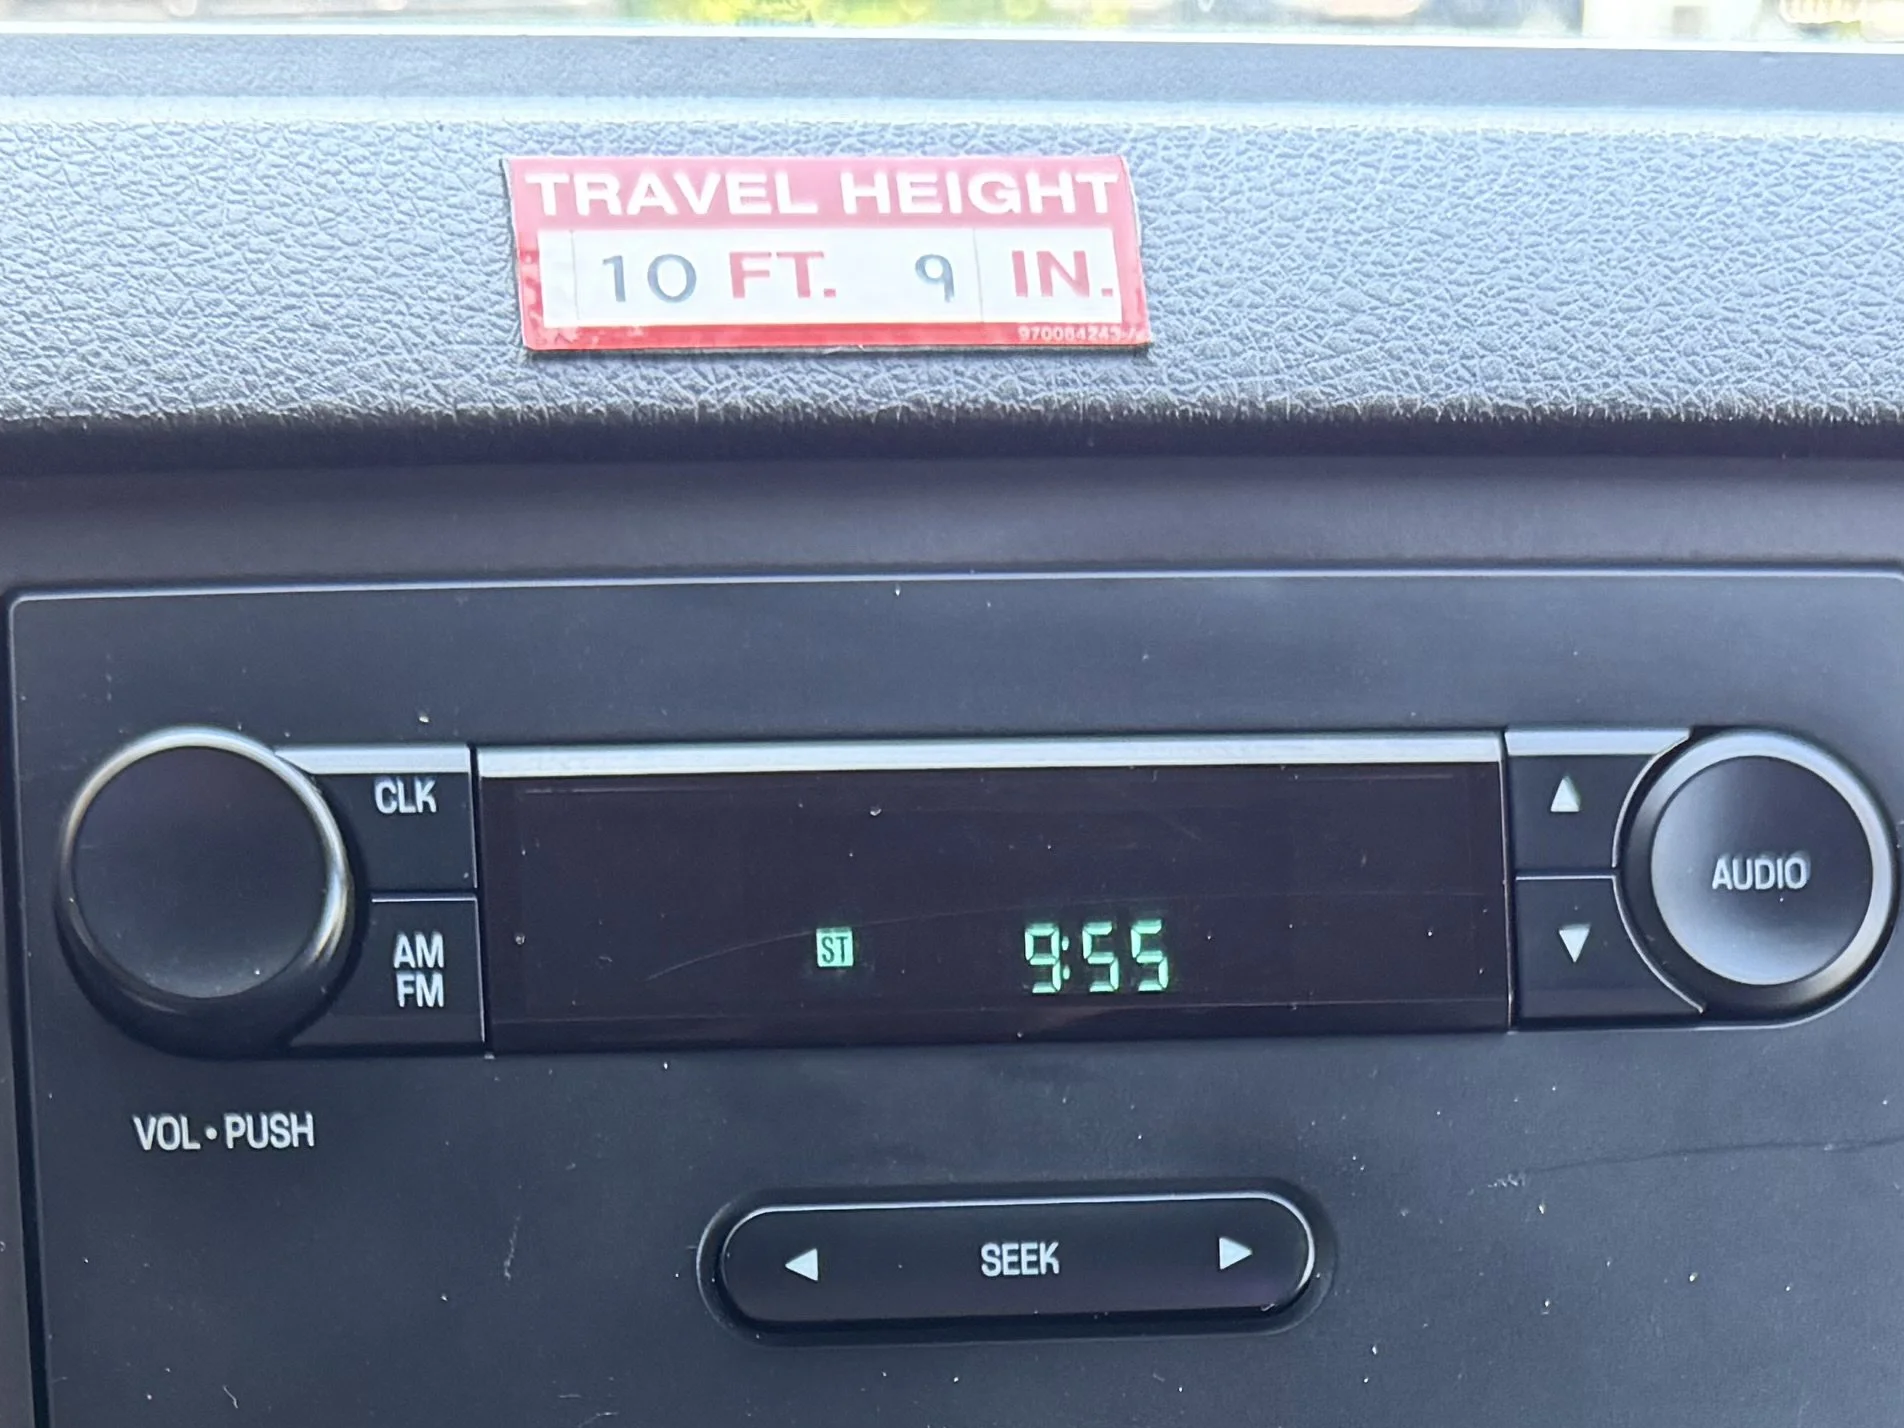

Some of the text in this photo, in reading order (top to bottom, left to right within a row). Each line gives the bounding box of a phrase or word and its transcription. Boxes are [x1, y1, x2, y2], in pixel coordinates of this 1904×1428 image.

[524, 169, 1119, 217] TRAVEL HEIGHT
[601, 248, 1116, 304] 10 FT. 9 IN.
[374, 778, 438, 814] CLK
[1711, 854, 1810, 890] AUDIO
[392, 932, 445, 970] AM
[818, 930, 853, 966] ST
[1023, 918, 1170, 995] 9:55
[396, 971, 445, 1008] FM
[133, 1112, 315, 1152] VOL PUSH
[980, 1241, 1061, 1278] SEEK
